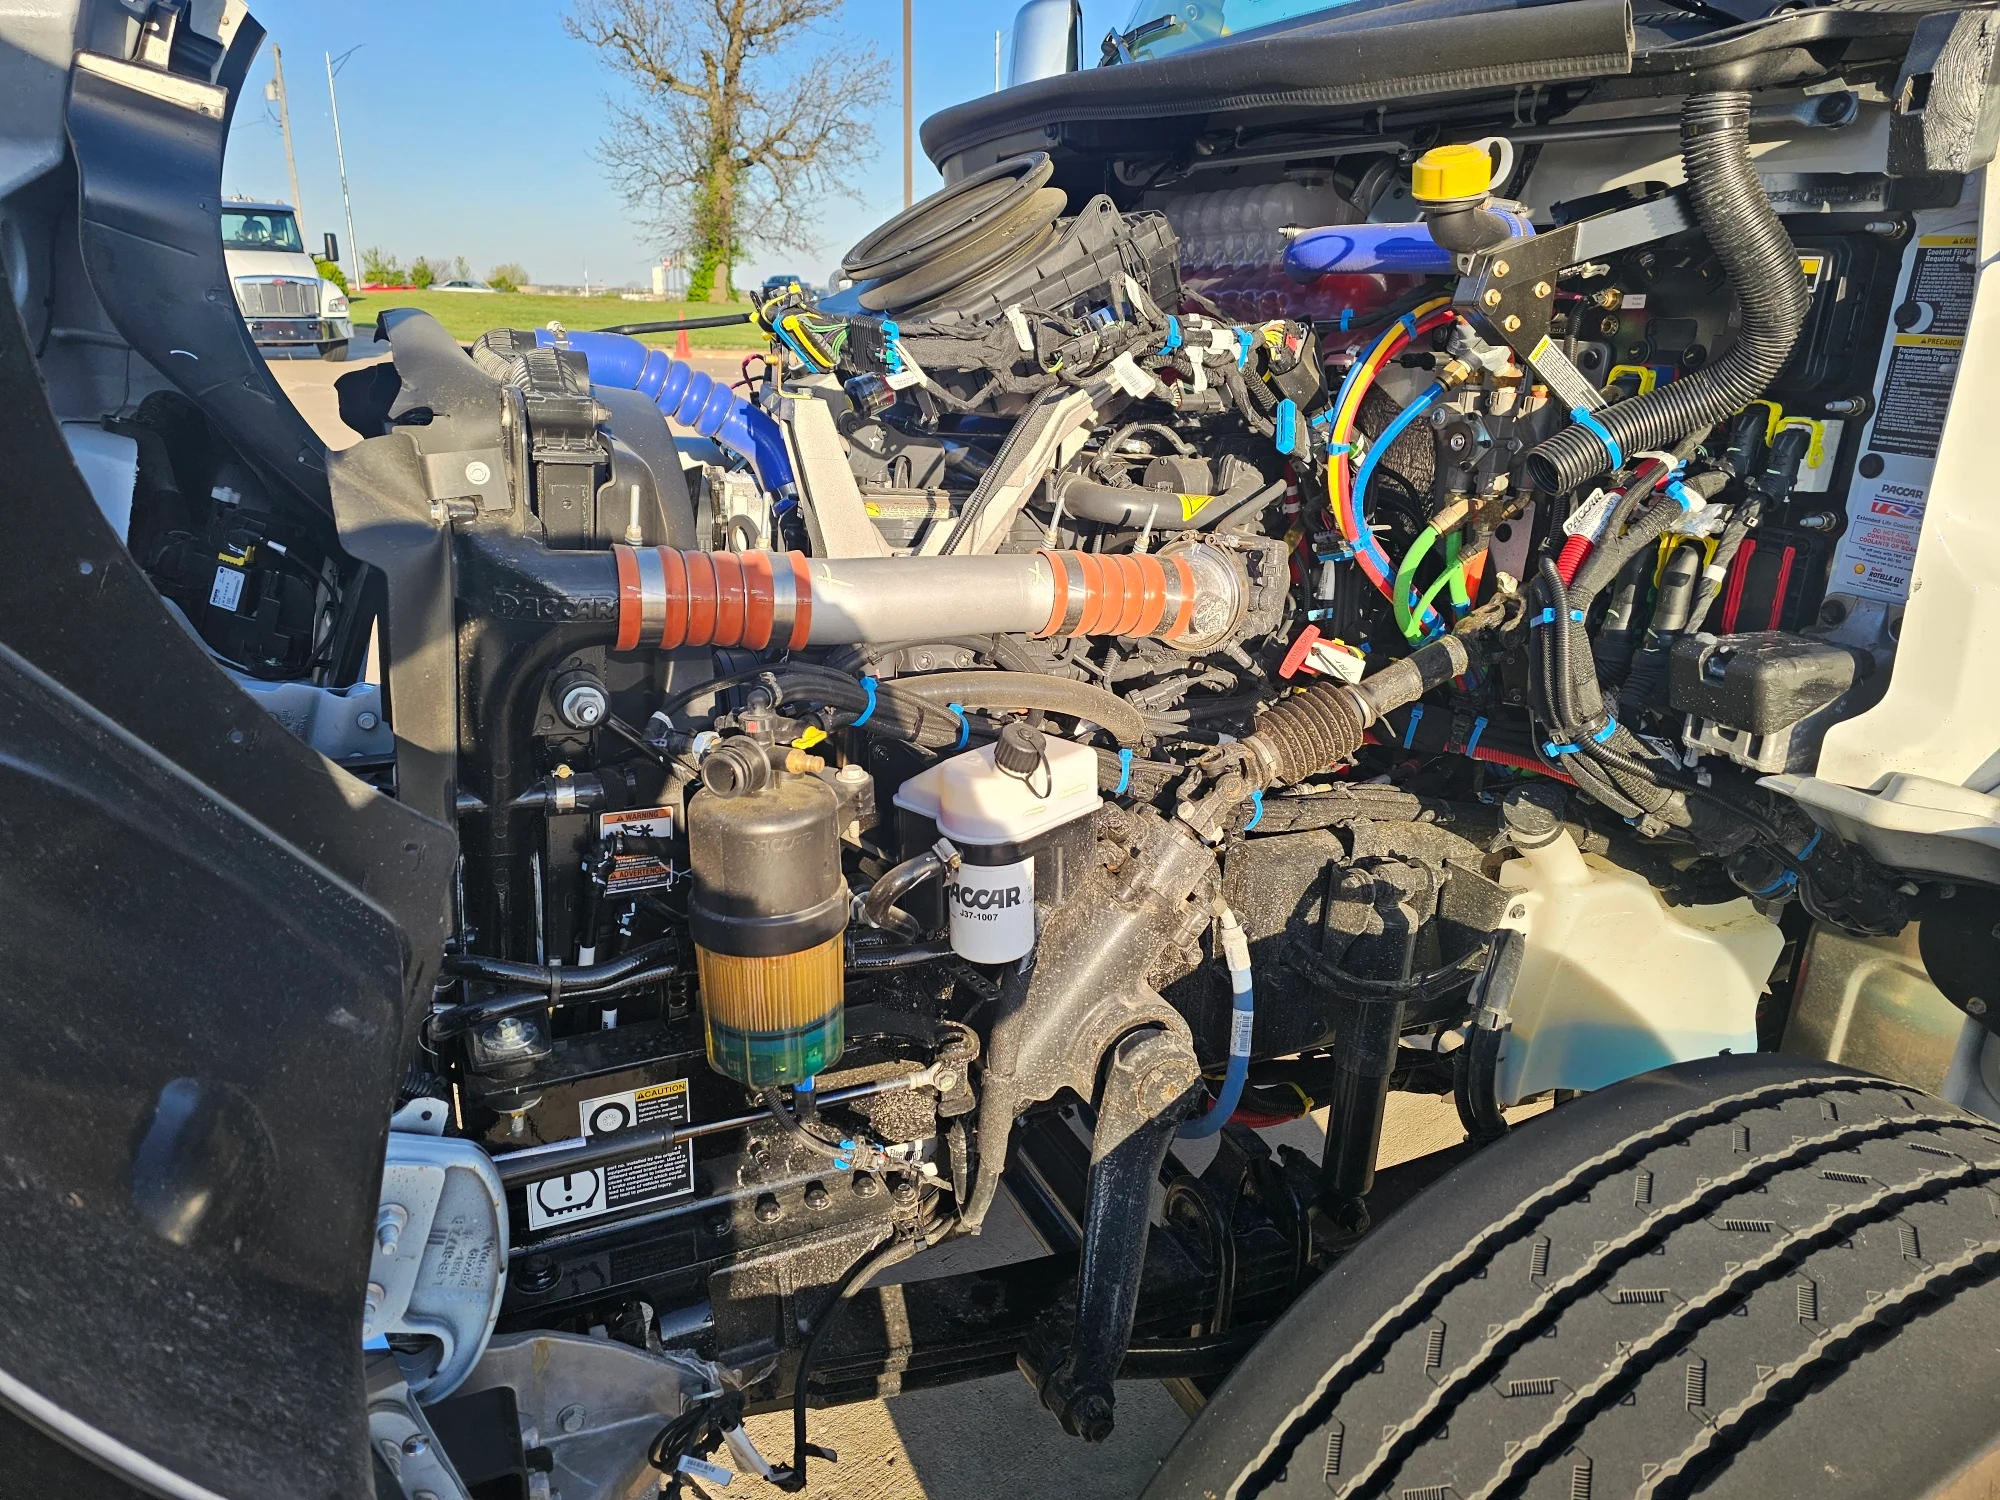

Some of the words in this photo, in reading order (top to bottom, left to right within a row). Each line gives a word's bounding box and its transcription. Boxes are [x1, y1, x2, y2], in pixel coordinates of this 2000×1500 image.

[1532, 340, 1548, 361] CAUTION
[1898, 347, 1930, 355] Procedimiento
[1904, 354, 1932, 362] Refrigerante
[1881, 484, 1924, 499] PACCAR
[1566, 492, 1603, 533] PACCAR
[1871, 501, 1925, 520] TRP
[1857, 515, 1880, 523] Extended
[1893, 522, 1914, 530] Coolant
[1860, 537, 1889, 547] COOLANTS
[1867, 533, 1911, 546] CONVENTIONAL
[626, 812, 658, 821] WARNING
[952, 881, 1021, 911] ACCAR
[960, 909, 998, 922] J37-1007
[645, 1084, 685, 1097] CAUTION
[627, 1158, 646, 1166] installed
[663, 1150, 680, 1158] original
[607, 1167, 632, 1175] equipment
[633, 1160, 665, 1169] manufacturer.
[627, 1177, 653, 1186] component
[637, 1186, 657, 1194] personal
[458, 1246, 479, 1288] PACCAR
